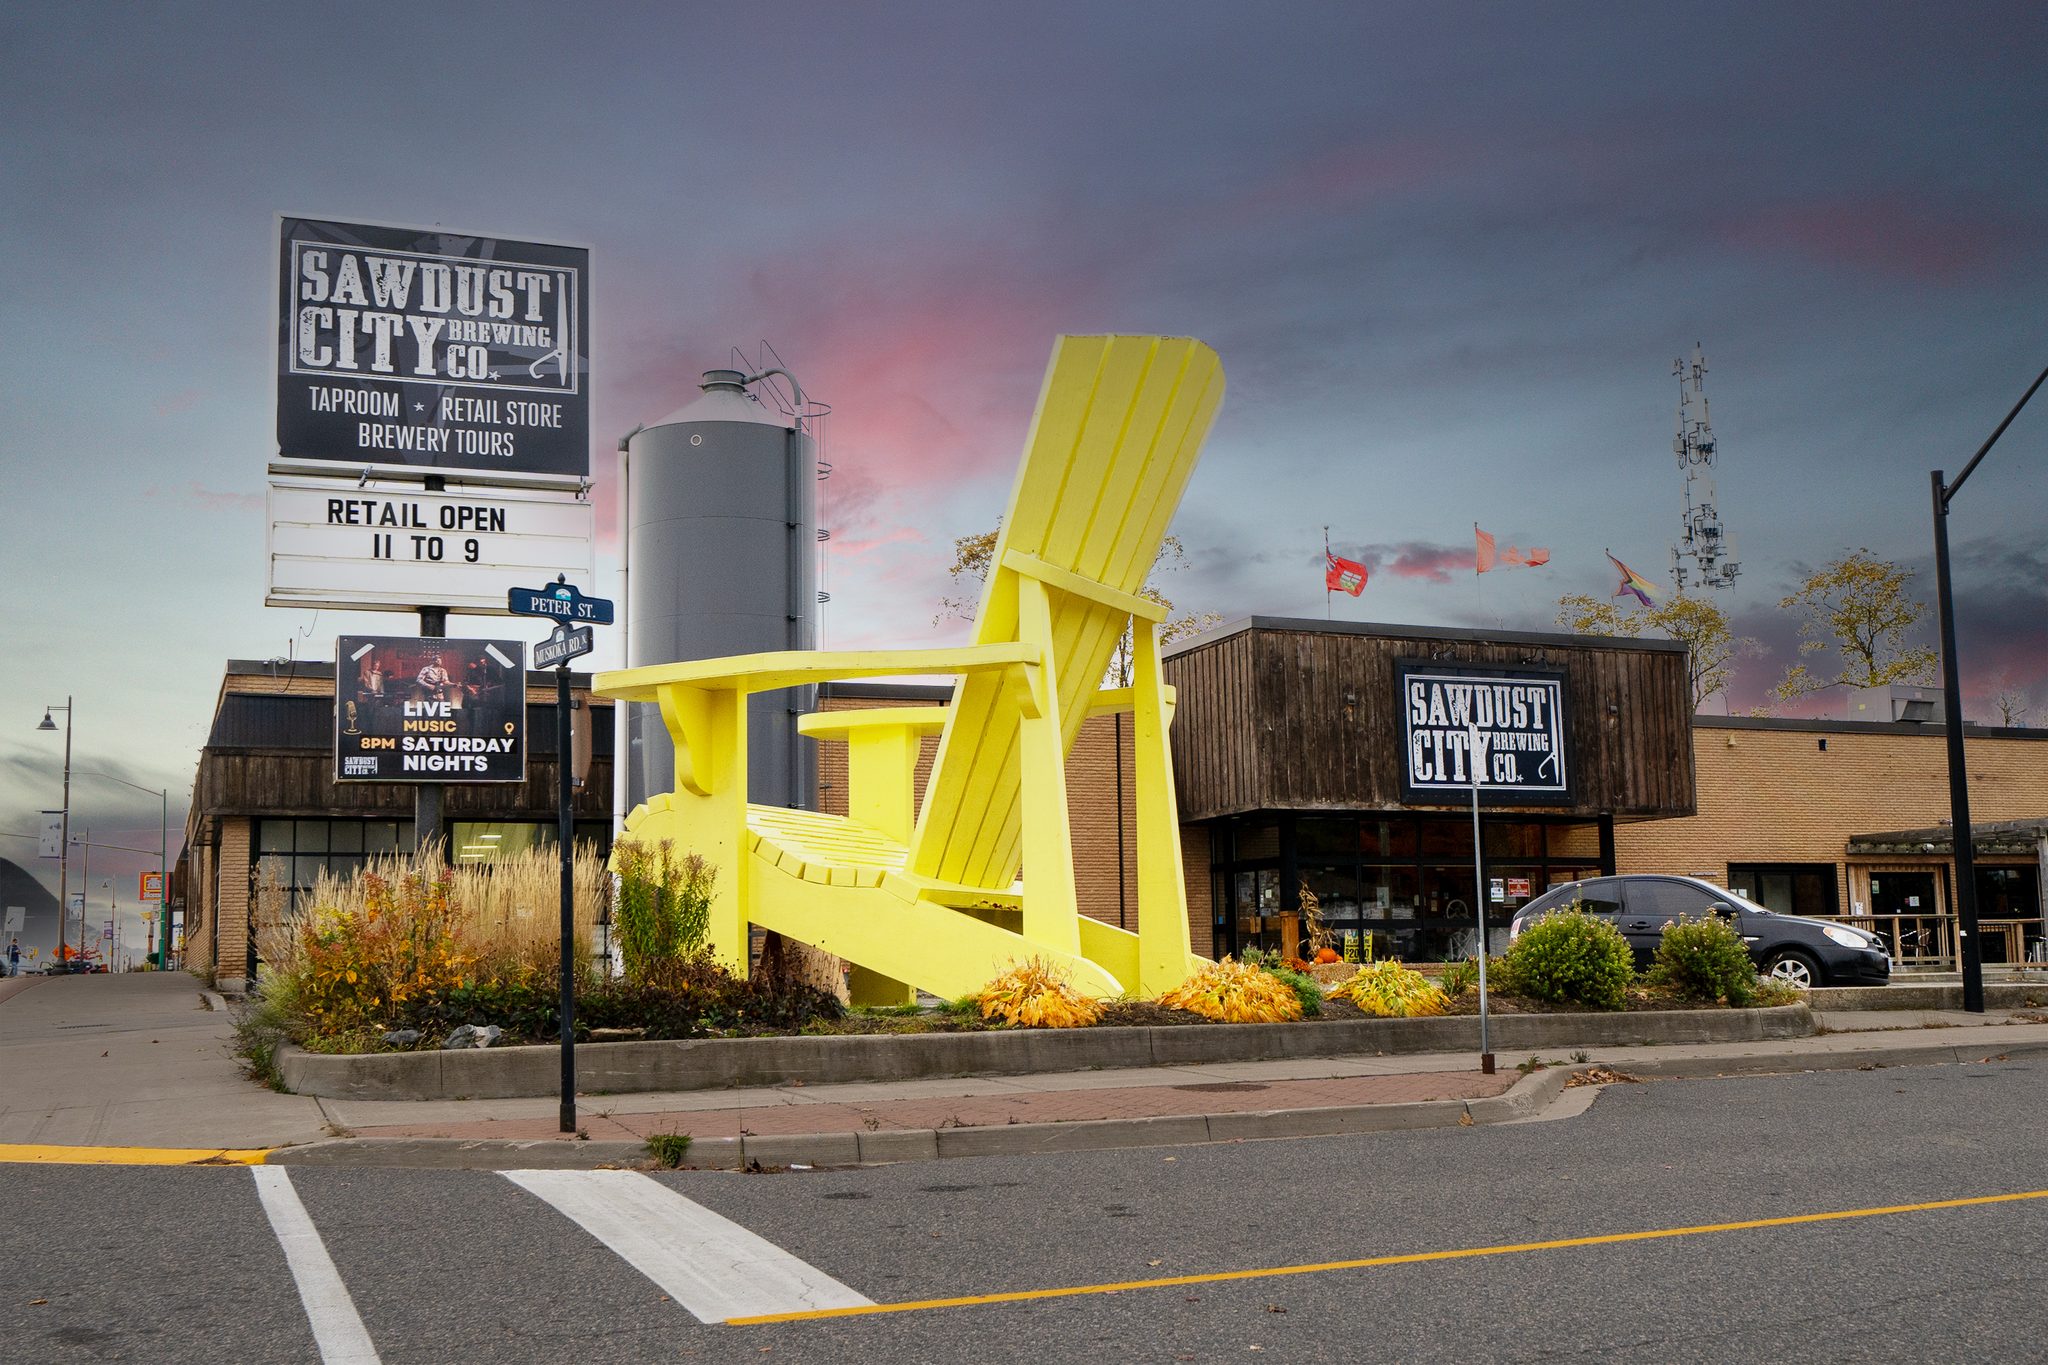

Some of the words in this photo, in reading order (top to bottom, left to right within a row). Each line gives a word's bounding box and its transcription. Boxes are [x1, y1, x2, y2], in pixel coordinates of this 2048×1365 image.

[301, 250, 551, 322] SAWDUST
[299, 306, 446, 376] CITY
[447, 319, 551, 348] BREWING
[309, 386, 399, 417] TAPROOM
[442, 397, 501, 424] RETAIL
[506, 401, 562, 428] STORE
[358, 423, 450, 452] BREWERY
[455, 429, 514, 457] TOURS
[327, 498, 427, 528] RETAIL
[440, 505, 506, 532] OPEN
[410, 535, 443, 560] TO
[464, 539, 479, 562] 9
[530, 596, 572, 616] PETER
[578, 603, 596, 618] ST.
[403, 701, 451, 717] LIVE
[1410, 682, 1547, 729] SAWDUST
[403, 720, 457, 733] MUSIC
[360, 737, 396, 750] 8PM
[402, 737, 515, 753] SATURDAY
[1492, 731, 1549, 751] BREWING
[403, 755, 488, 772] NIGHTS
